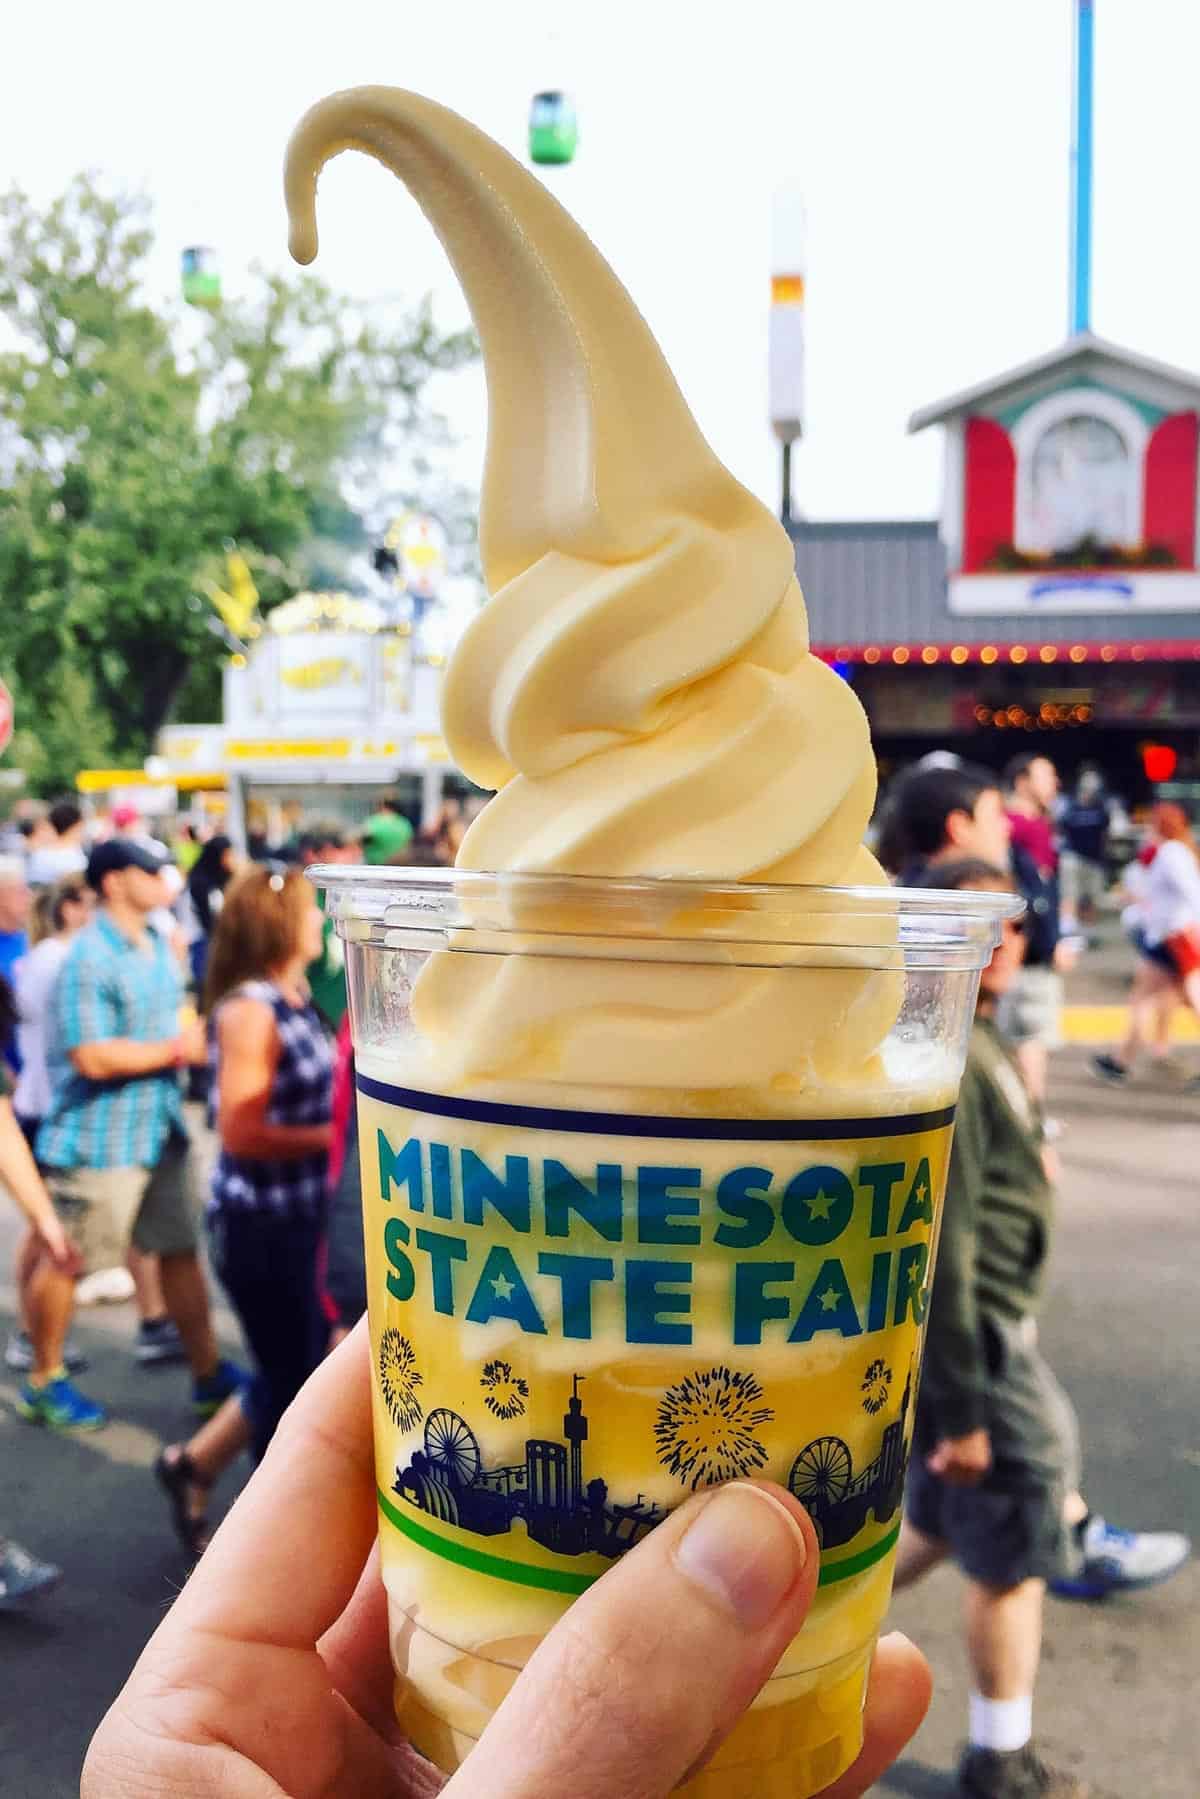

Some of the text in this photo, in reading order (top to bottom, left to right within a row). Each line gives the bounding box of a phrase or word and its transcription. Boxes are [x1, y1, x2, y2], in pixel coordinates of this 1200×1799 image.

[377, 1128, 933, 1248] MINNESOTA
[384, 1217, 926, 1345] STATE FAIR
